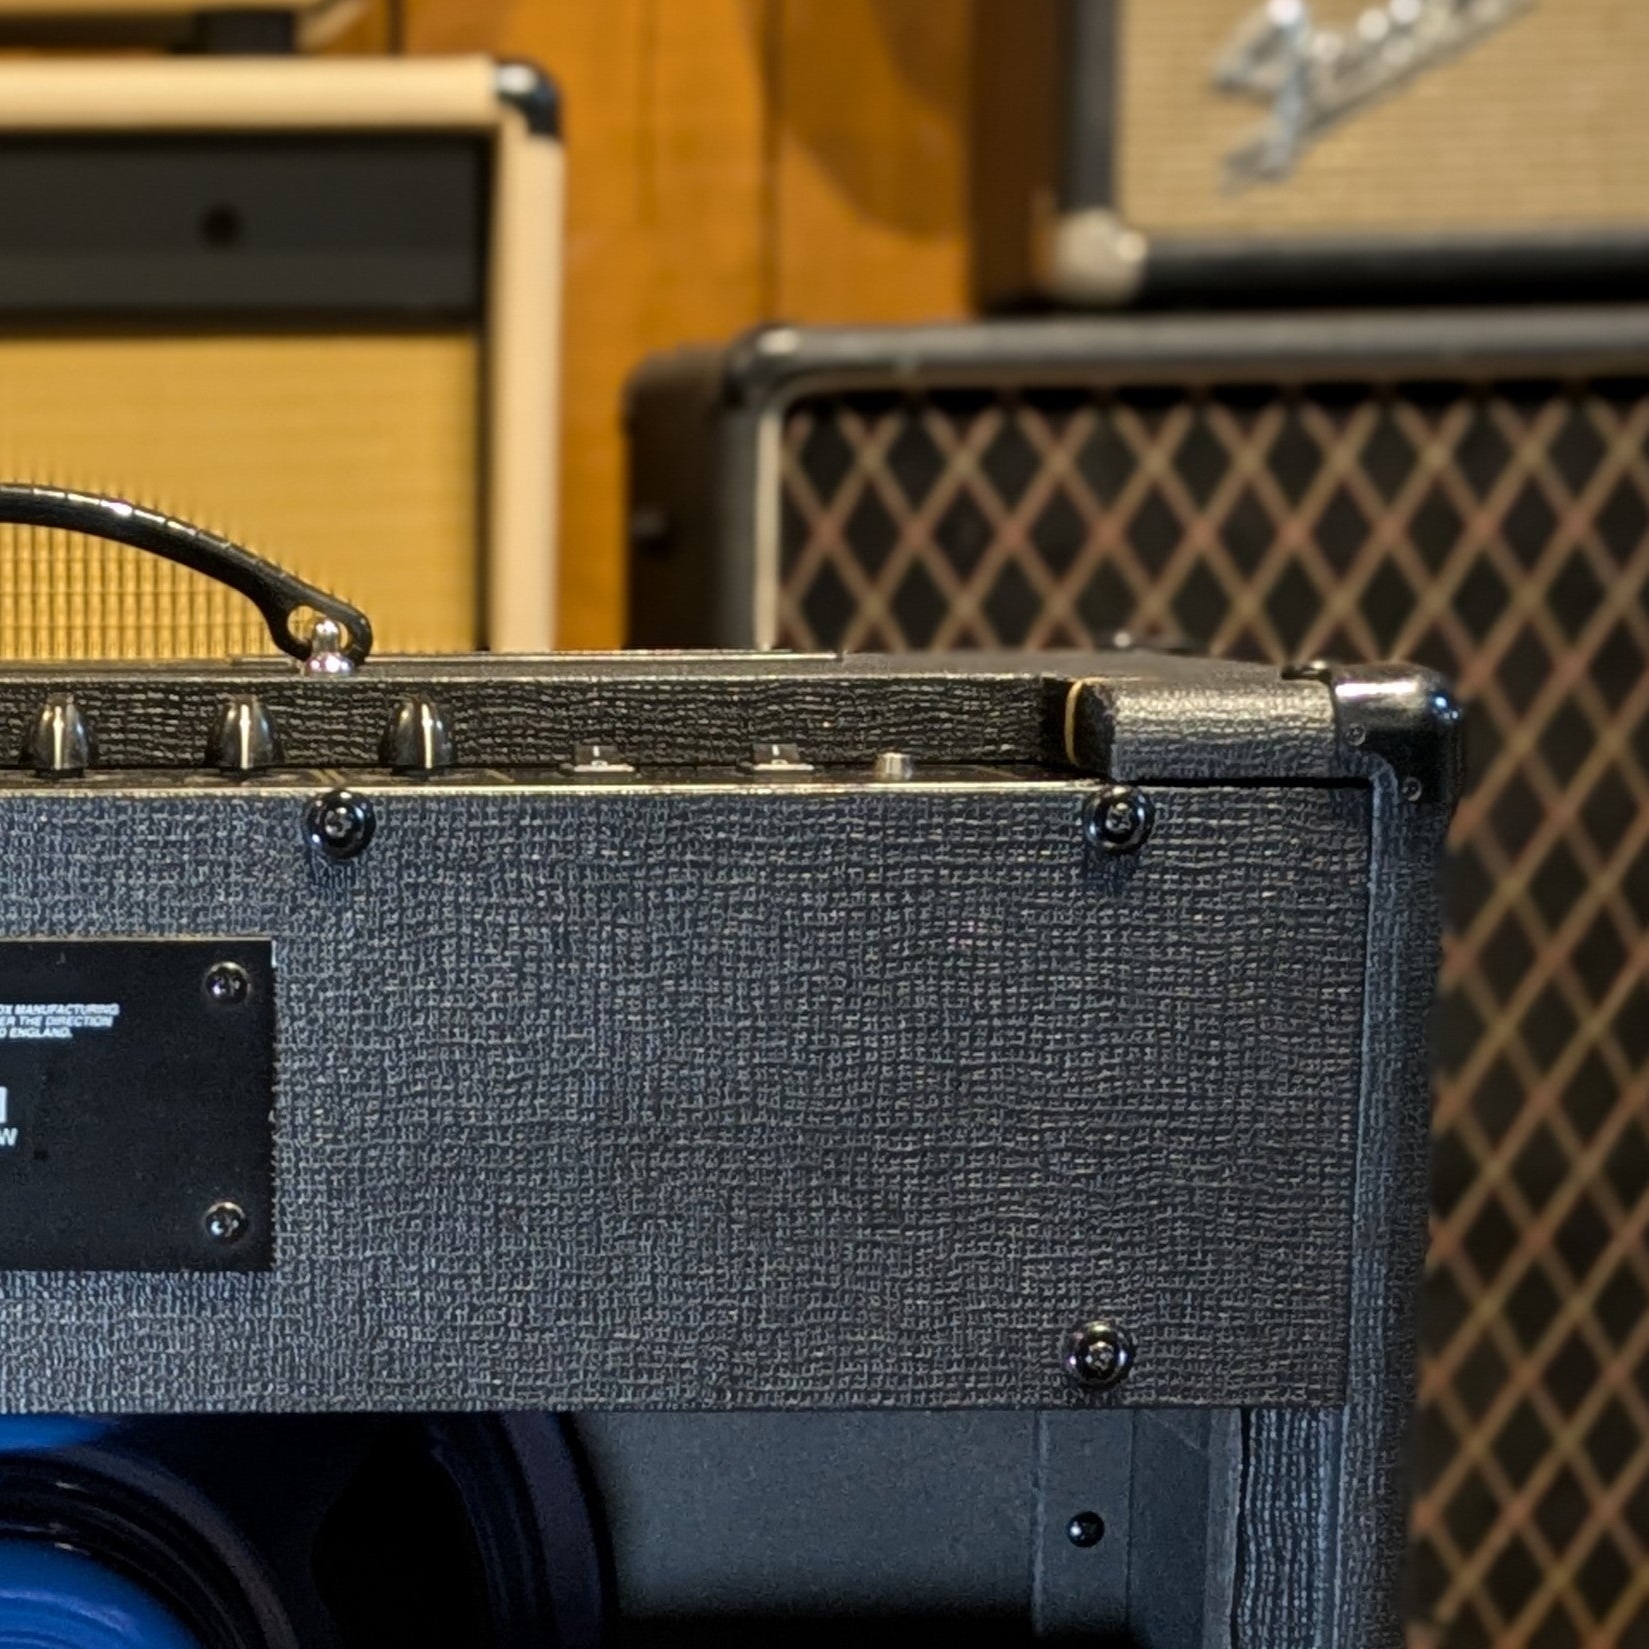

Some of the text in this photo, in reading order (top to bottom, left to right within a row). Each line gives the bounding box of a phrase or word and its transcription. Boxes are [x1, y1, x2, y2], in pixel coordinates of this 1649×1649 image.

[14, 1003, 120, 1016] MANUFACTURING
[18, 1016, 42, 1027] THE
[45, 1016, 114, 1028] DIRECTION
